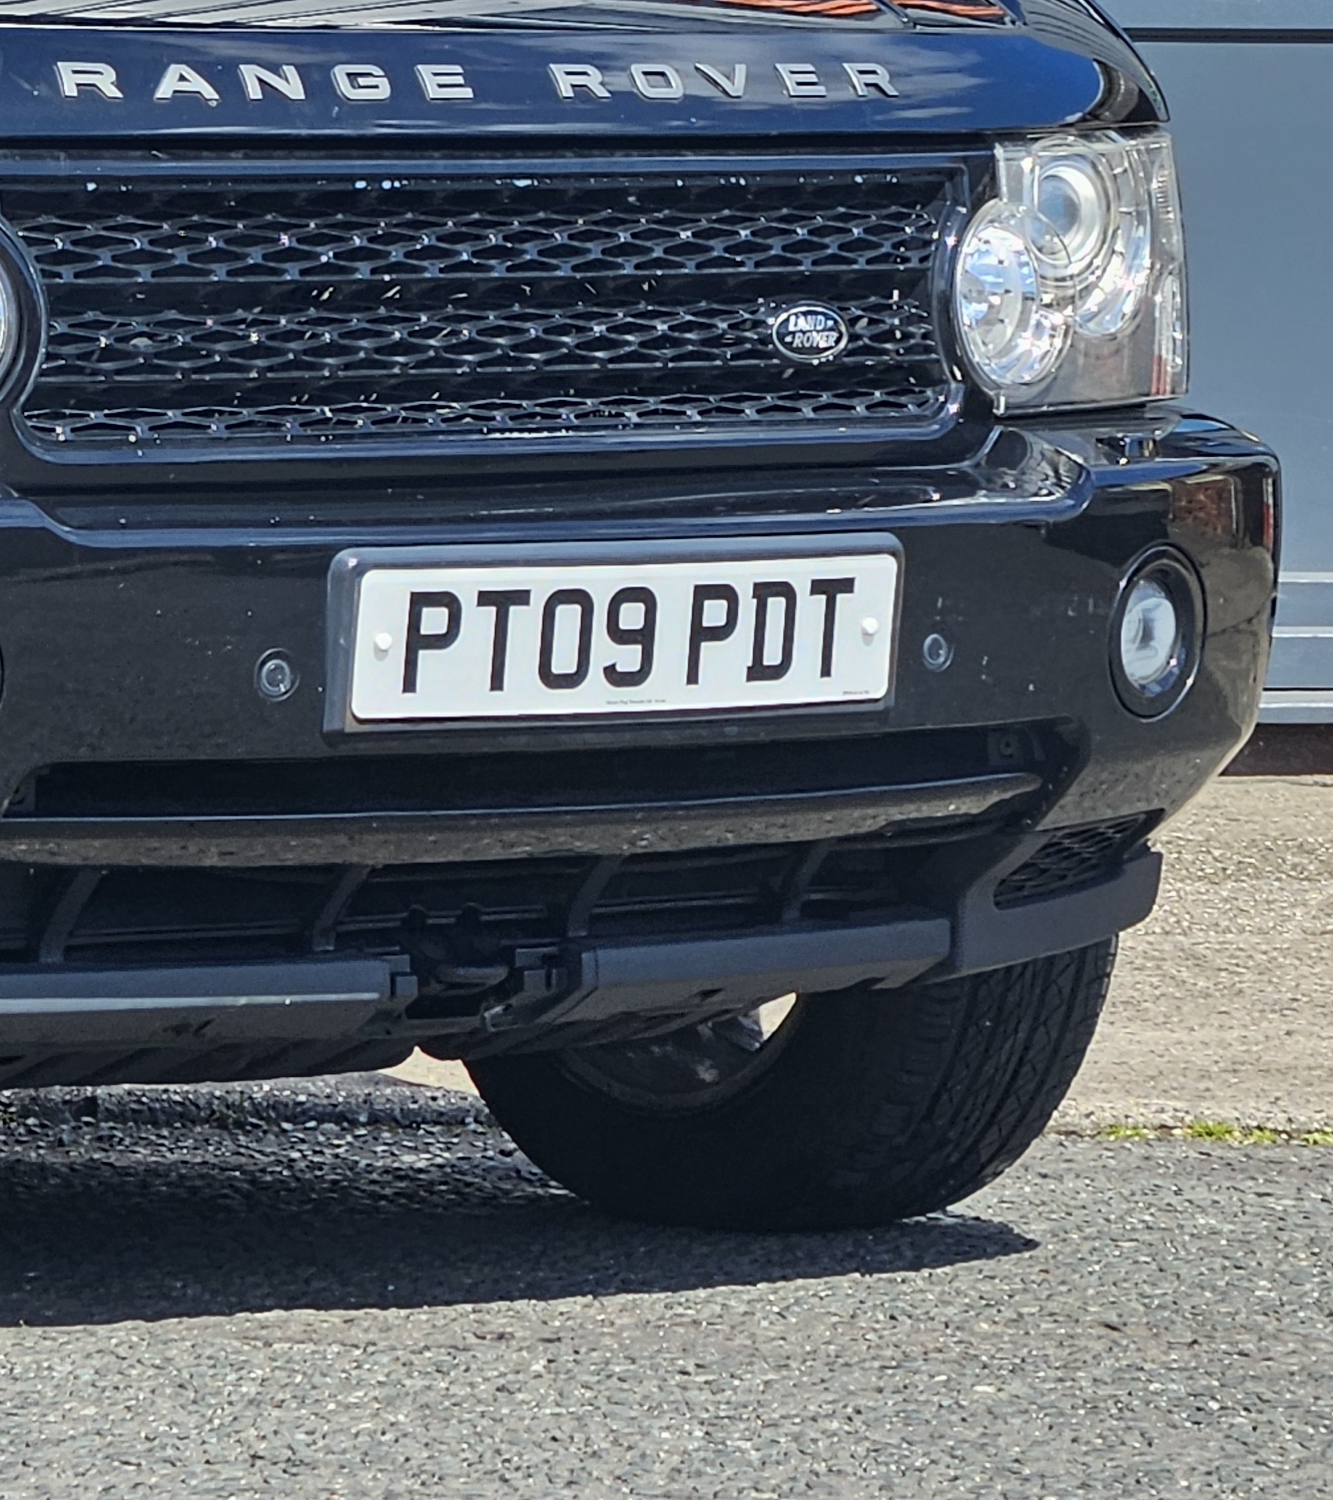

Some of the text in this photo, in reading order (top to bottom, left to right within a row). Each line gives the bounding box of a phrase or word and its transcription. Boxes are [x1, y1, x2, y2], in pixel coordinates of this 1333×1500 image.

[56, 61, 901, 106] RANGE ROVER
[788, 313, 826, 332] LAND
[792, 331, 839, 349] ROVER
[402, 577, 855, 694] PT09 PDT
